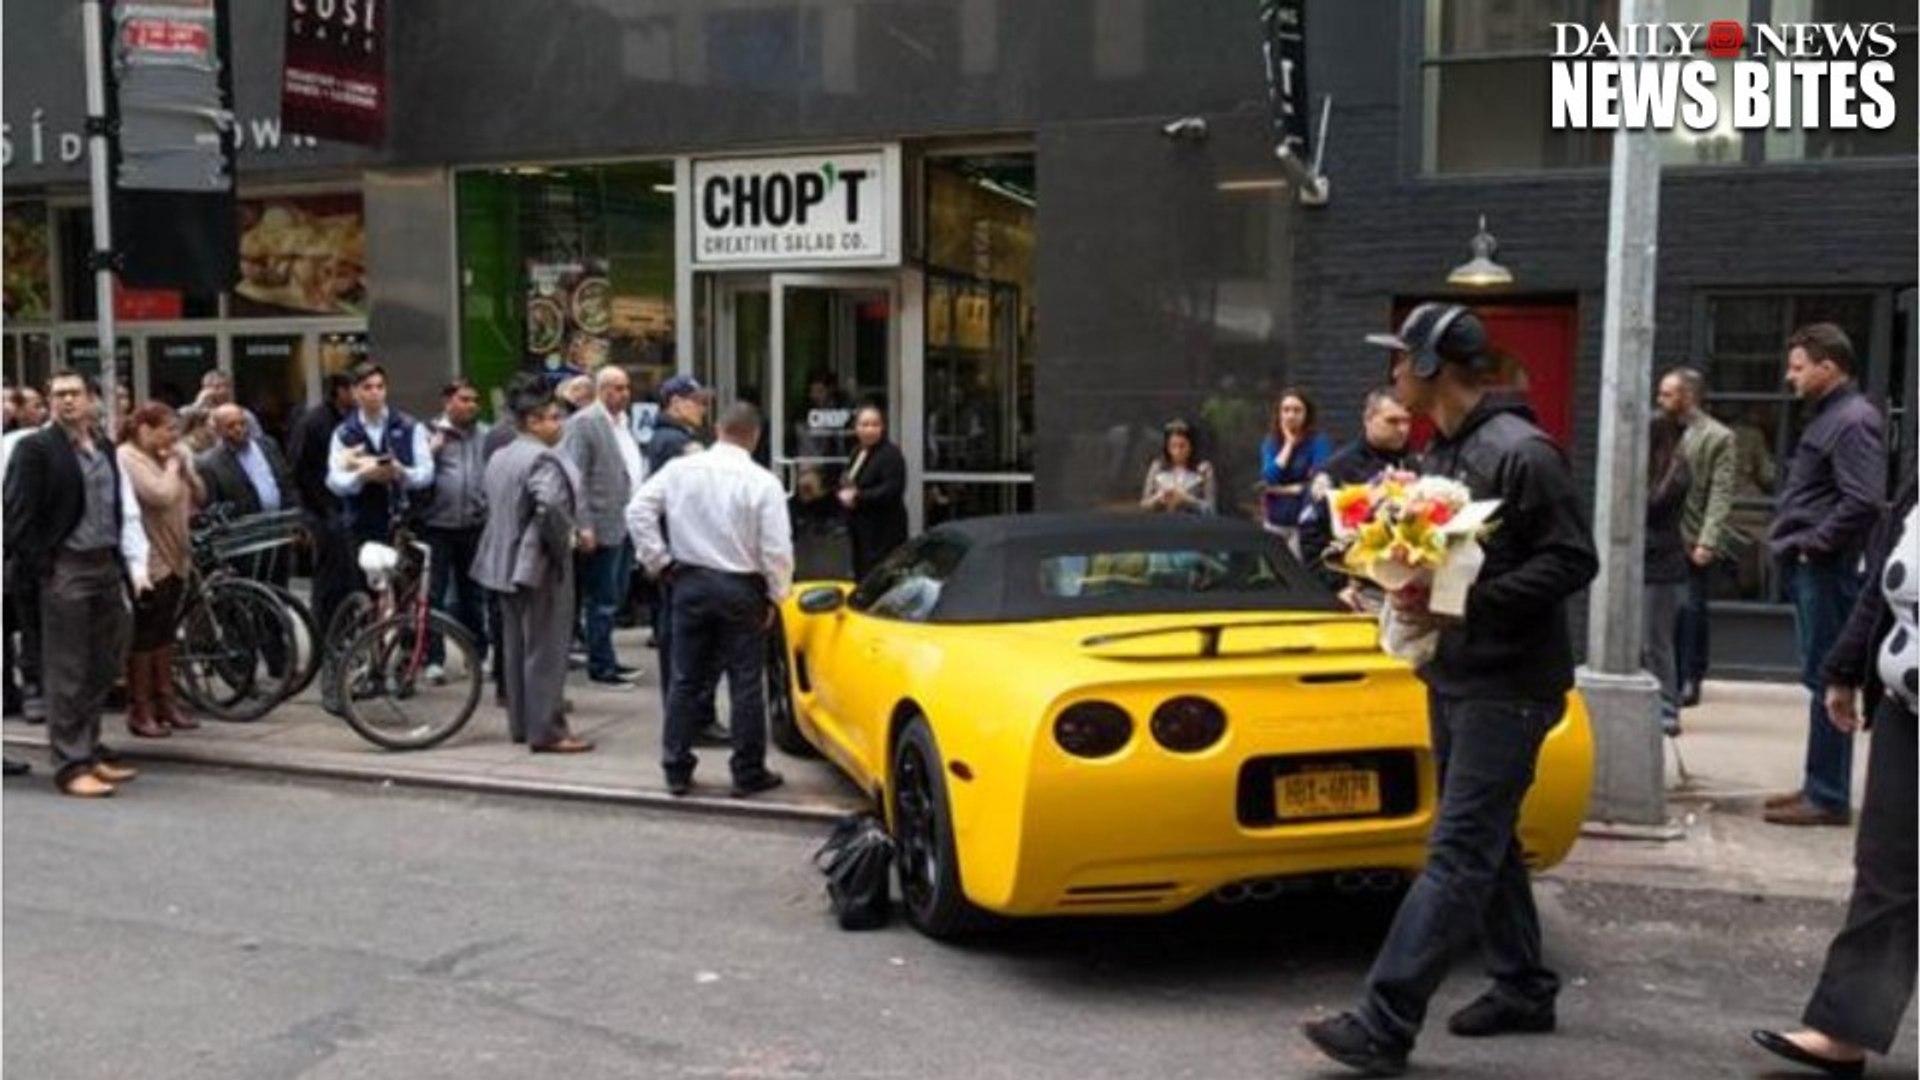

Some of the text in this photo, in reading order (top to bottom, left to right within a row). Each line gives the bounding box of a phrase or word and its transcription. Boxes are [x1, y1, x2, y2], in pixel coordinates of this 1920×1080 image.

[704, 161, 867, 229] CHOP'T
[705, 232, 868, 254] CREATIVE SALAD CO.
